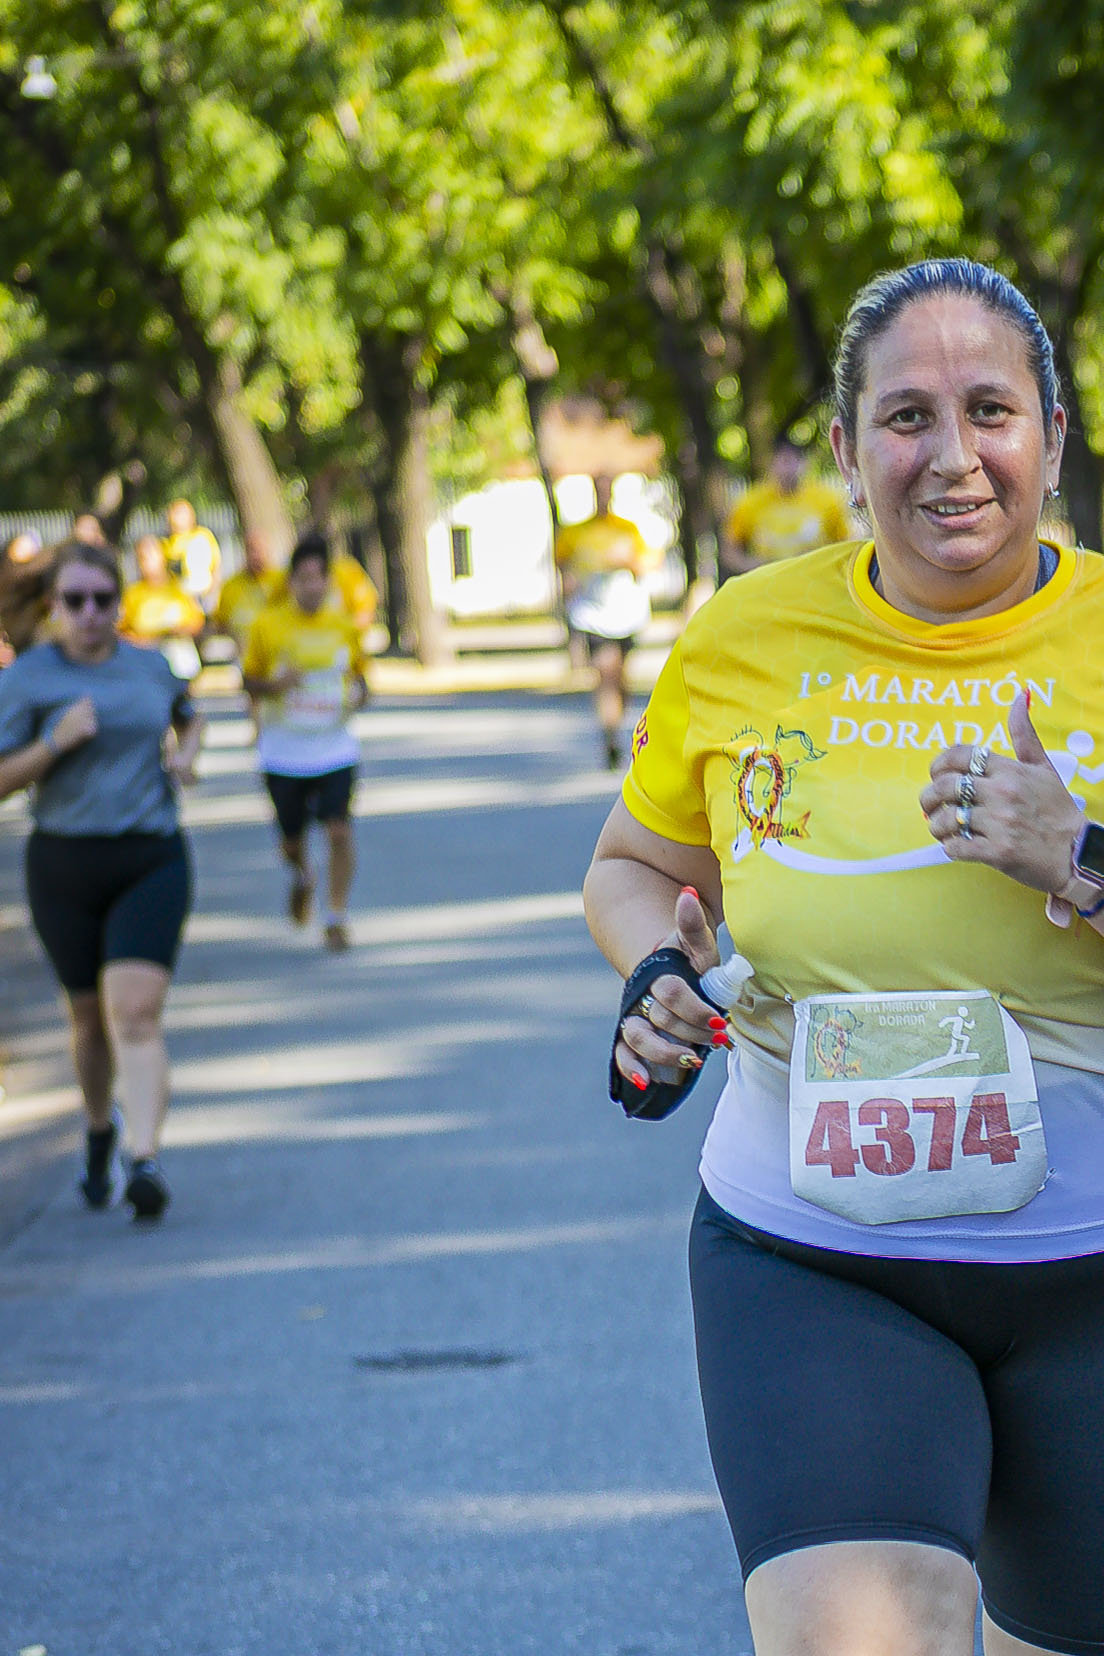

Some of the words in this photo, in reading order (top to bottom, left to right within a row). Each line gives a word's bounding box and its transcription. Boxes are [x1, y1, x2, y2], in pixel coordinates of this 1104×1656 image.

[840, 671, 1056, 708] MARATÓN
[827, 715, 1012, 751] DORADA
[878, 1013, 926, 1026] DORADA
[805, 1092, 1022, 1179] 4374
